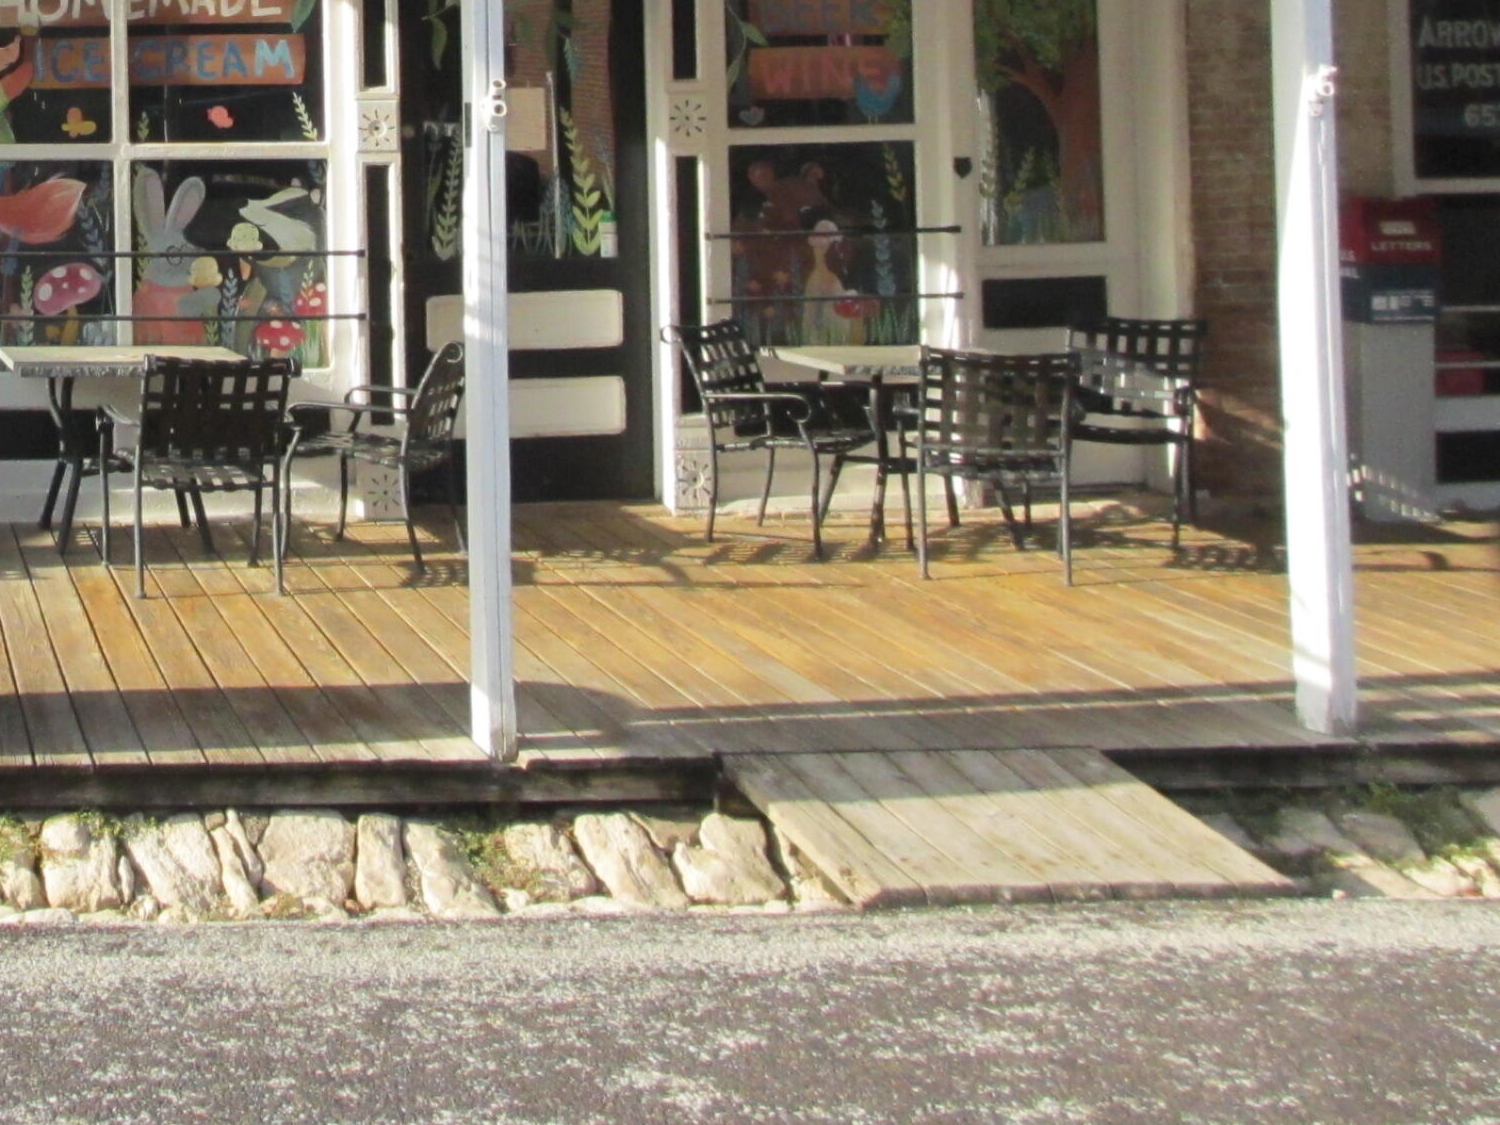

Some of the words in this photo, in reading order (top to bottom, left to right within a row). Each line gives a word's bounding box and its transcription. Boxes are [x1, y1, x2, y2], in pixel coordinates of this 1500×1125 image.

[35, 39, 109, 83] ICE
[134, 38, 295, 78] CREAM
[1464, 103, 1500, 127] 65
